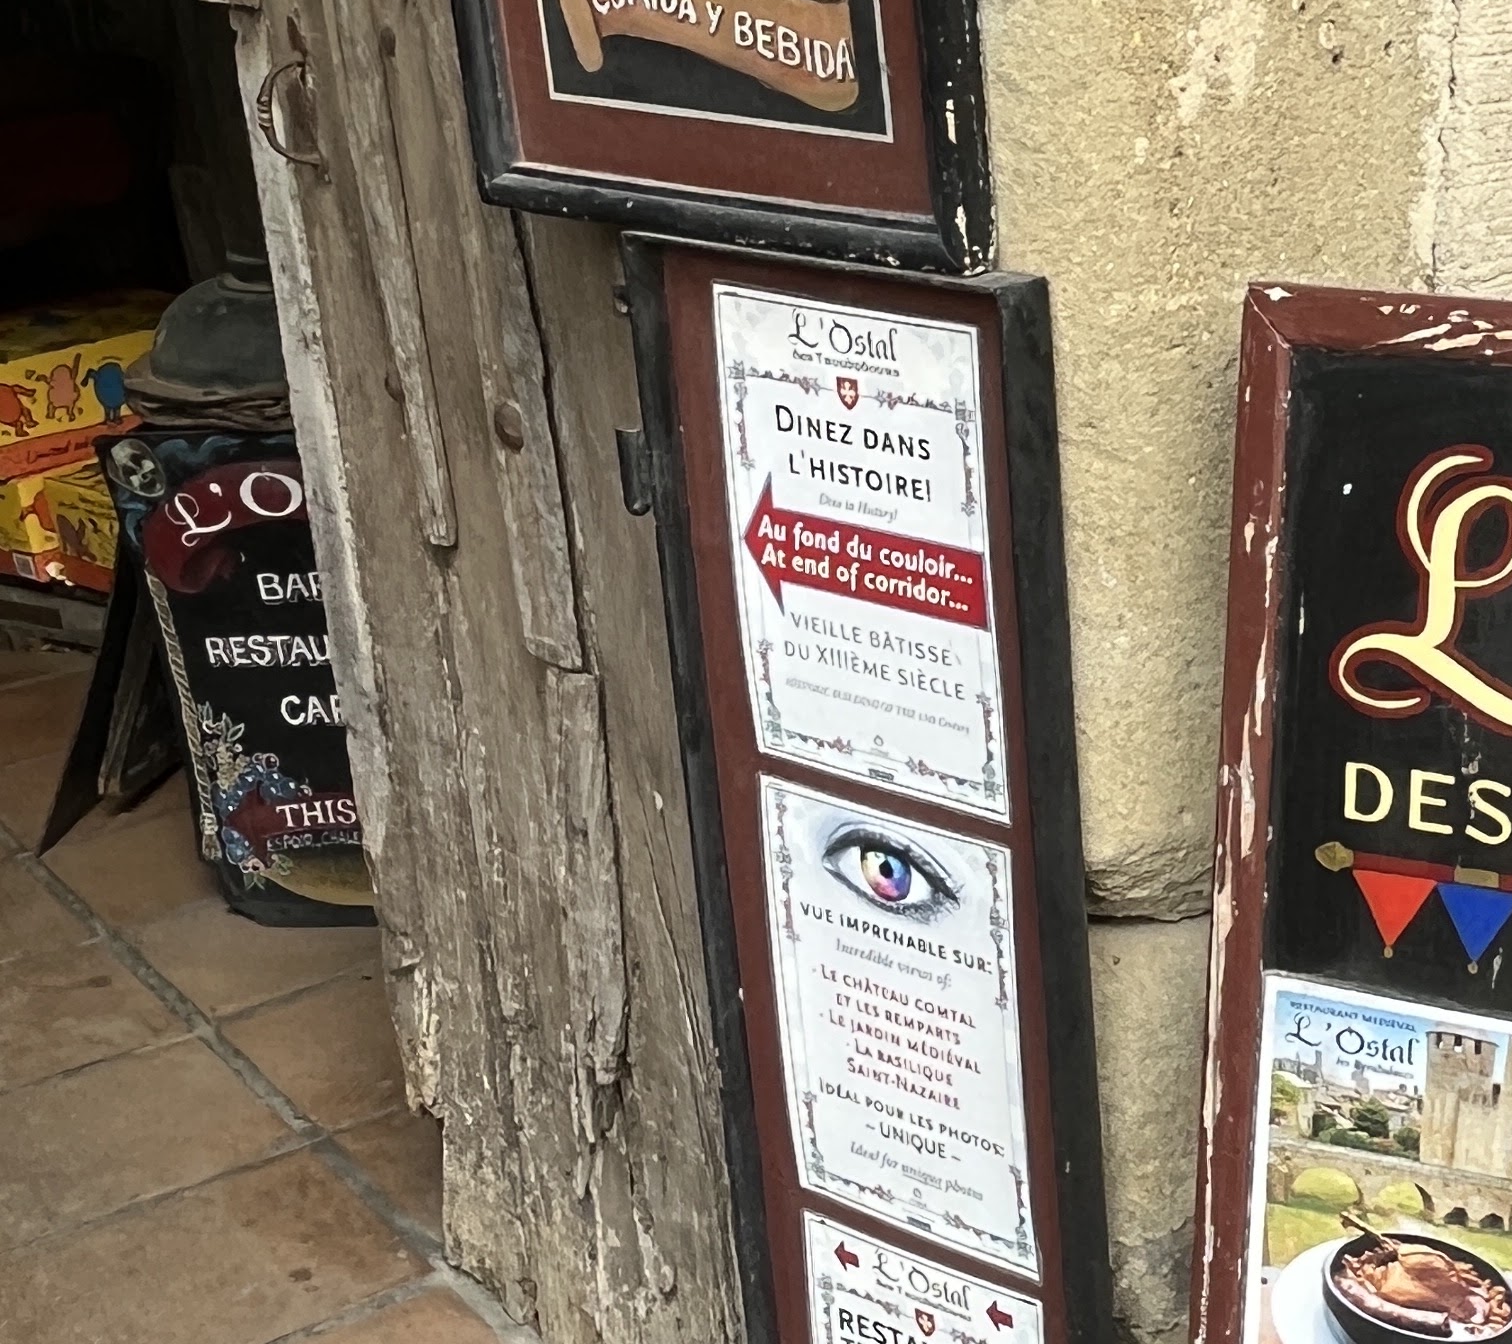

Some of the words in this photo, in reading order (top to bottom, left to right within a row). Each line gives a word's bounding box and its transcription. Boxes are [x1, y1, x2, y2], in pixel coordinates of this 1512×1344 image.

[706, 1, 722, 34] Y
[734, 12, 856, 81] BEBIDA
[788, 309, 897, 361] L'Ostal
[776, 405, 852, 445] DINEZ
[864, 429, 930, 459] DANS
[789, 450, 931, 502] L'HISTOIRE!
[758, 516, 786, 542] Au
[794, 523, 840, 552] fond
[846, 536, 872, 562] du
[880, 548, 972, 584] couloir...
[761, 544, 785, 568] At
[792, 557, 830, 578] end
[836, 564, 858, 591] of
[864, 572, 968, 612] corridor...
[790, 612, 862, 644] VIEILLE
[784, 640, 809, 660] DU
[898, 668, 966, 700] SIÈCLE
[276, 798, 357, 828] THIS
[800, 902, 834, 924] VUE
[840, 914, 947, 960] IMPRENABLE
[953, 949, 992, 975] SUR:
[857, 1000, 880, 1017] LES
[1285, 1012, 1420, 1065] L'Ostal
[866, 1096, 904, 1120] POUR
[909, 1113, 933, 1131] LES
[939, 1123, 1005, 1157] PHOTOS
[880, 1122, 947, 1158] UNIQUE
